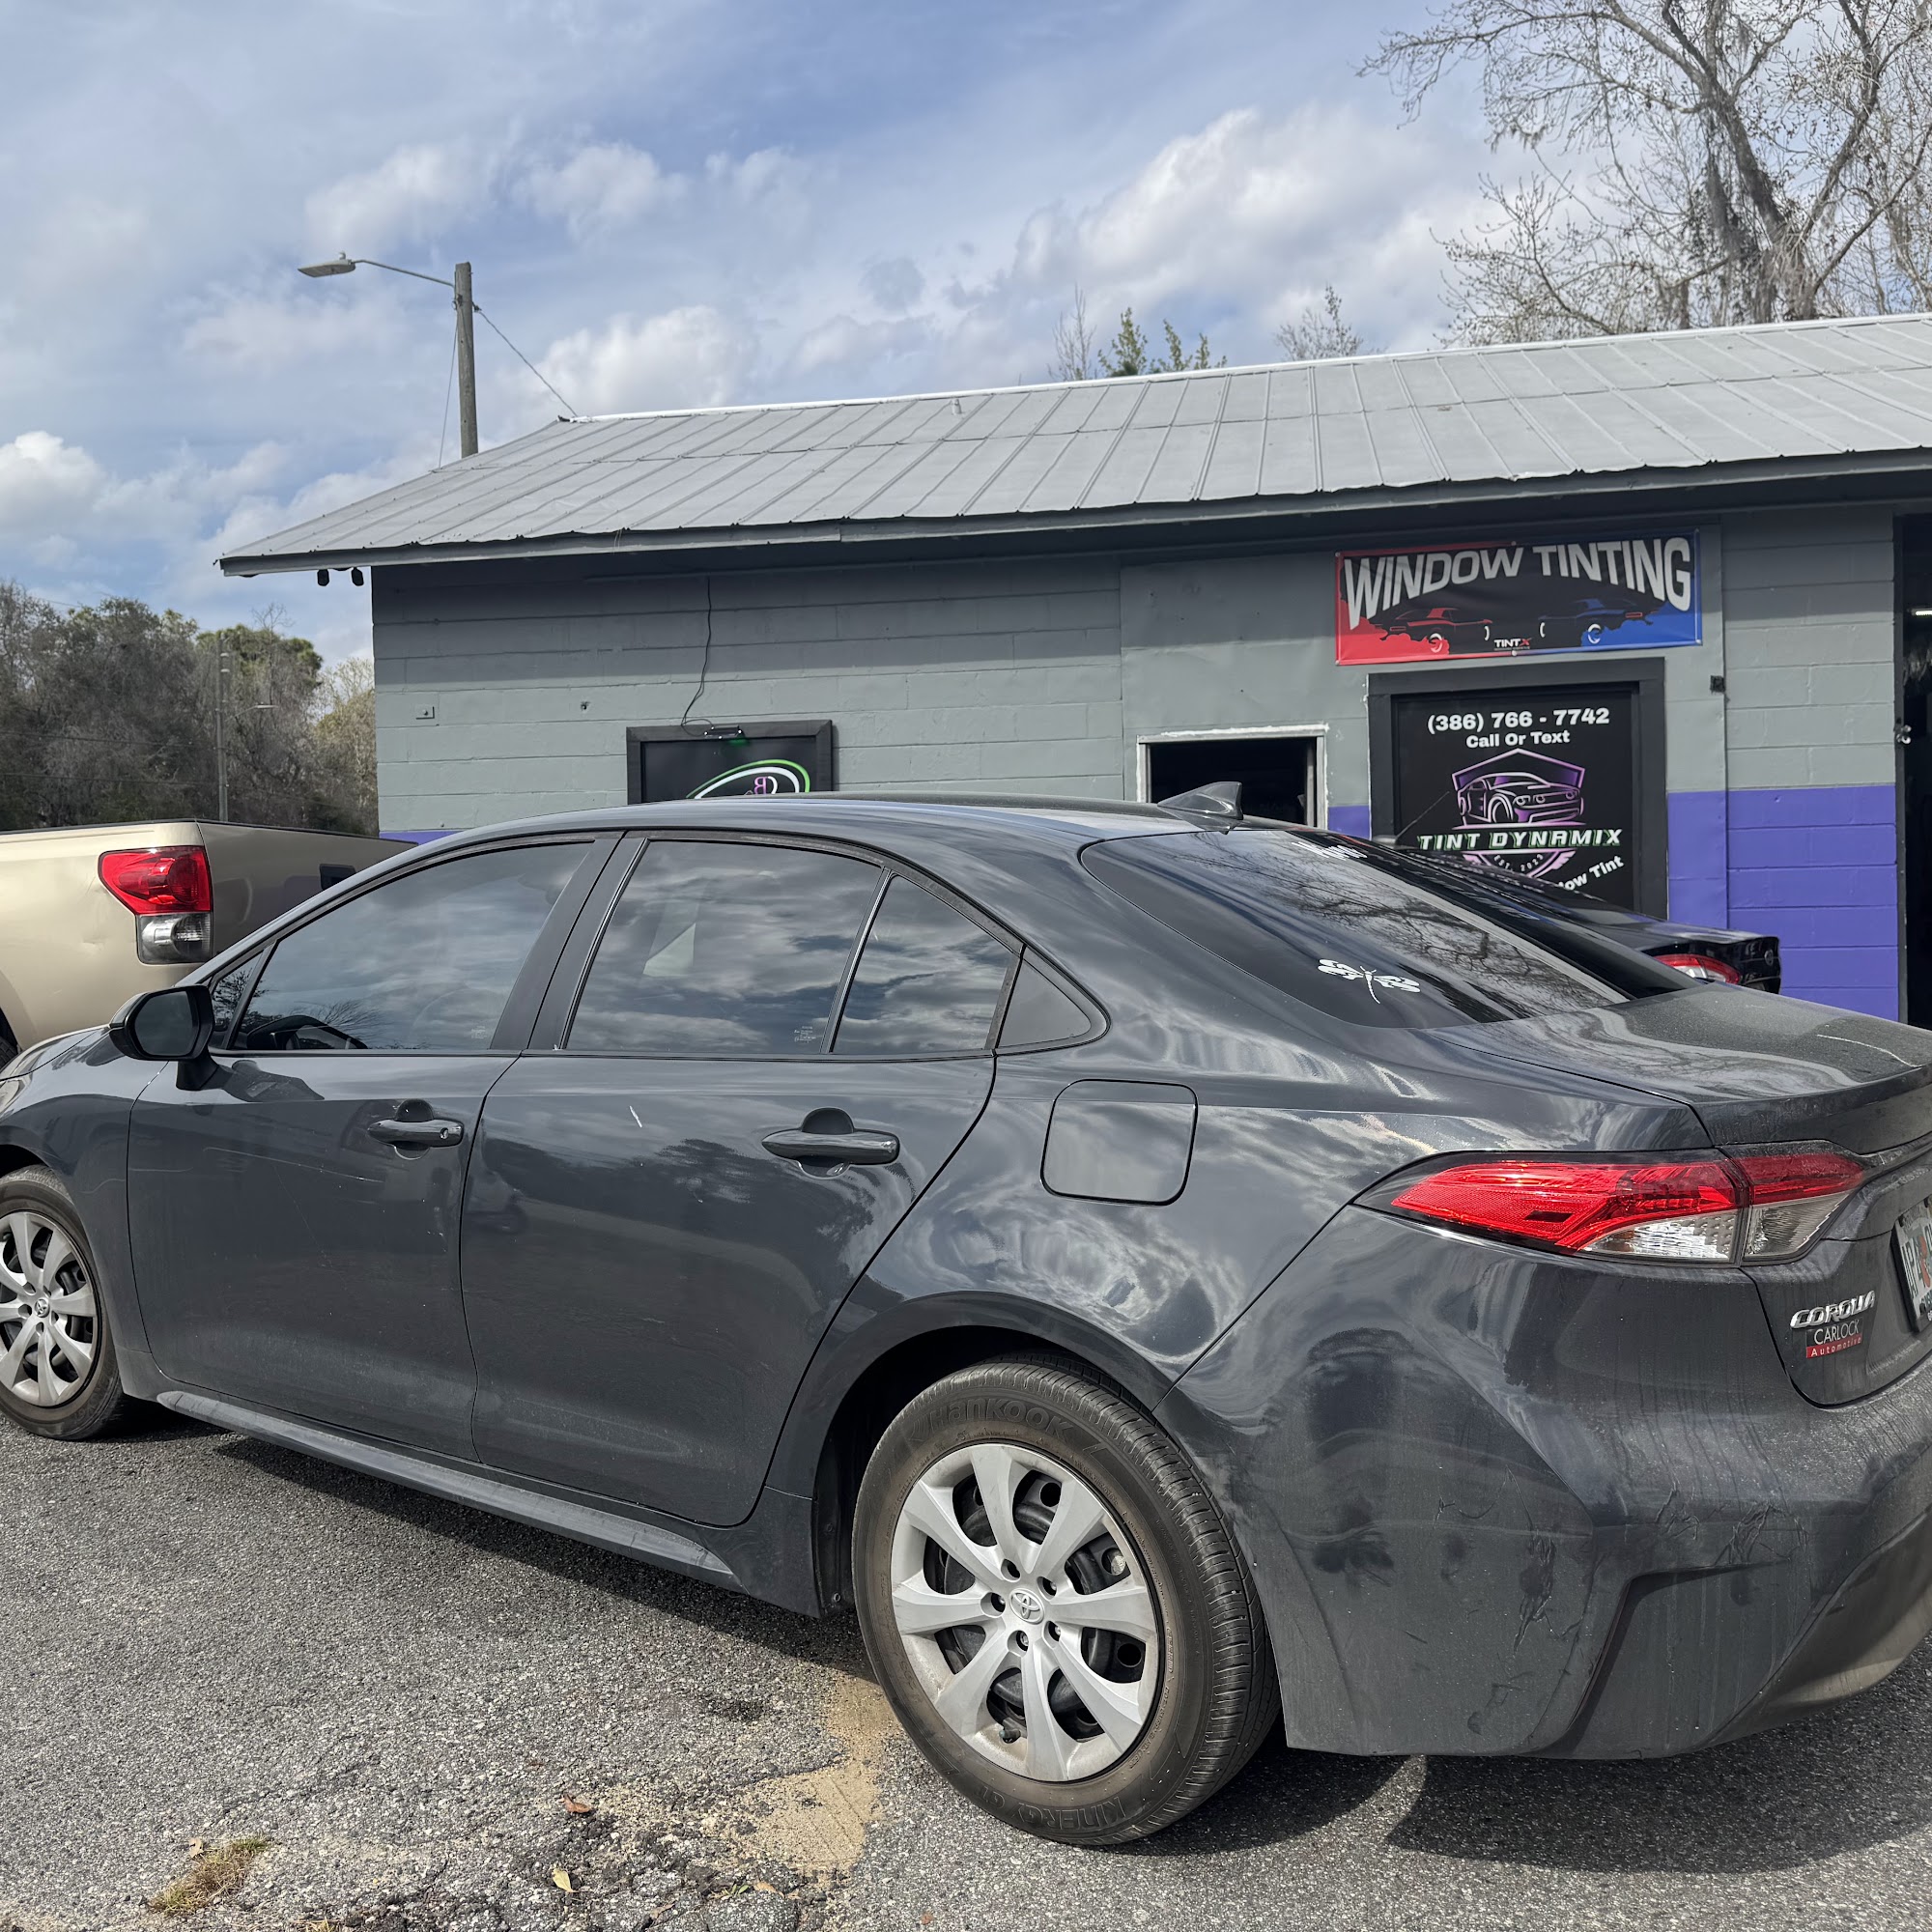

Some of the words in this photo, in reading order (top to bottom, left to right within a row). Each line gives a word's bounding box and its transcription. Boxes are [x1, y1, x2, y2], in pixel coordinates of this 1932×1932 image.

[1344, 547, 1524, 630] WINDOW
[1532, 537, 1690, 611] TINTING
[1427, 713, 1484, 734] (386)
[1491, 711, 1533, 728] 766
[1553, 707, 1610, 725] 7742
[1466, 733, 1499, 749] Call
[1505, 732, 1526, 746] Or
[1530, 729, 1571, 745] Text
[1417, 833, 1480, 850] TINT
[1489, 829, 1623, 850] DYNAMIX
[1589, 855, 1624, 878] Tint
[1790, 1290, 1876, 1329] COROLLA
[1813, 1320, 1860, 1345] CARLOCK
[1810, 1336, 1862, 1357] Automotive
